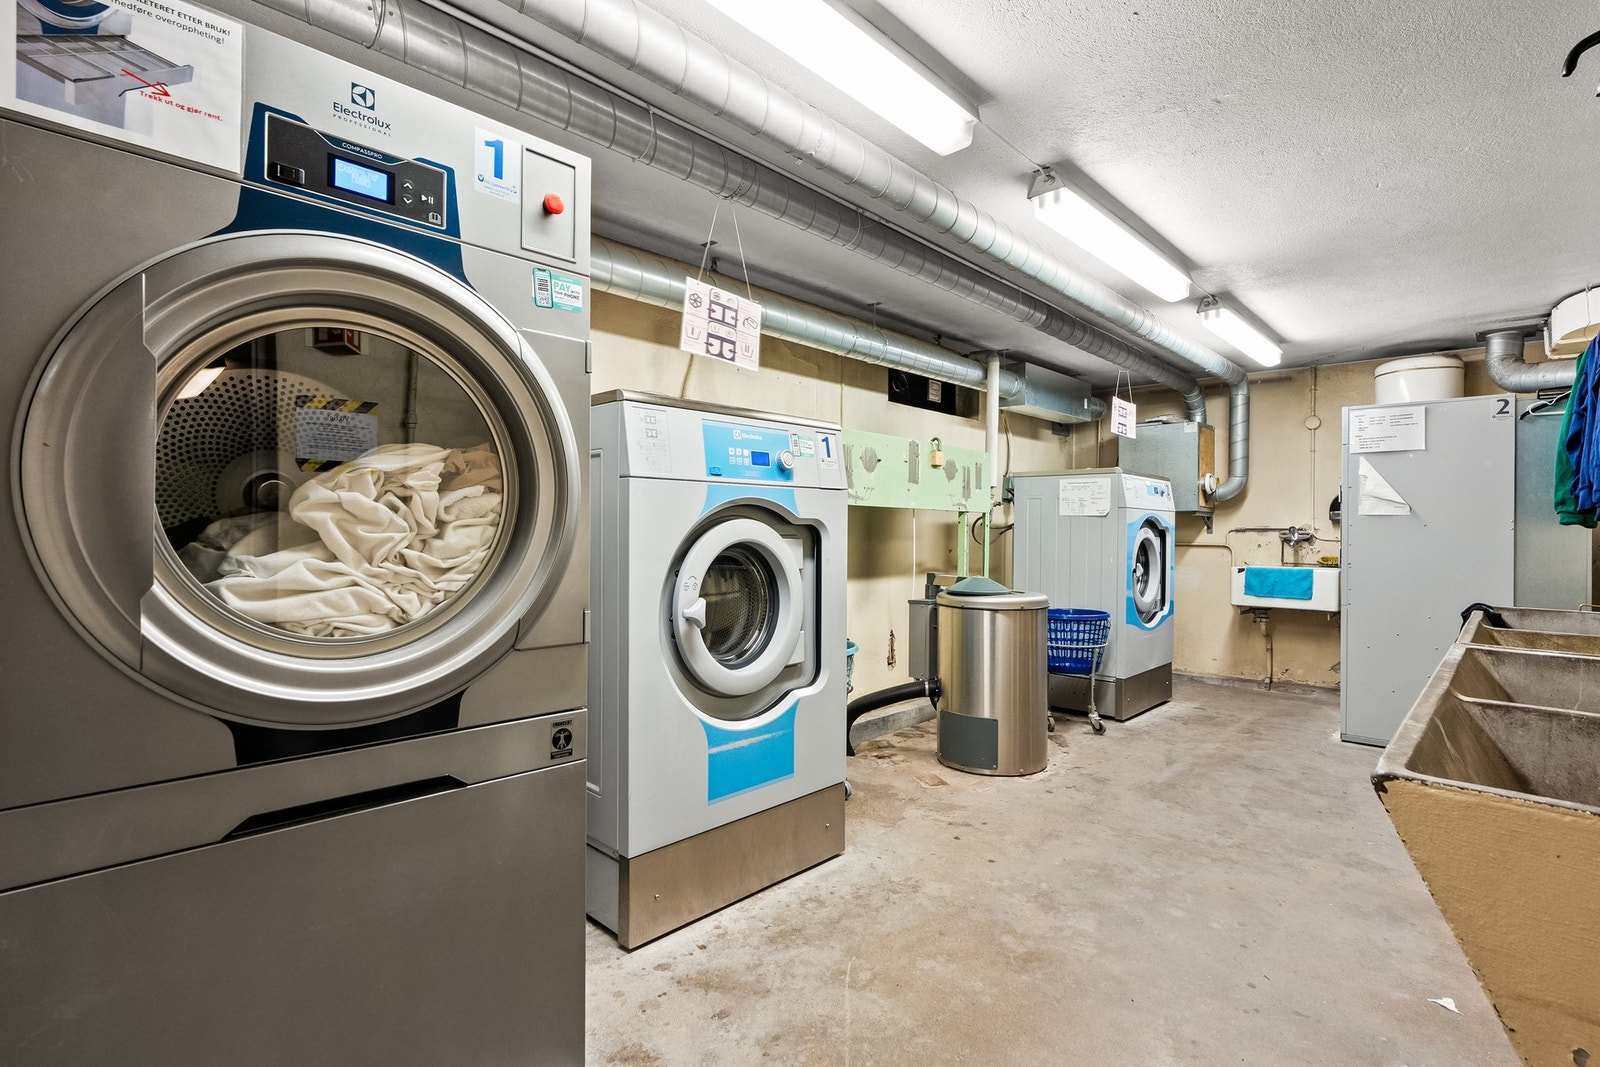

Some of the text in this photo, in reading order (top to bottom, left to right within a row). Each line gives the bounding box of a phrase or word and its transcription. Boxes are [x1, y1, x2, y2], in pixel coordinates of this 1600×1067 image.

[155, 14, 225, 45] overoppheting!
[177, 11, 203, 26] ETTER
[204, 21, 231, 37] BRUK!
[140, 90, 163, 103] Trekk
[175, 103, 185, 111] og
[333, 101, 391, 131] Electrolux
[333, 113, 391, 138] PROFESSIONAL
[341, 142, 383, 159] COMPASSPRO
[484, 139, 504, 180] 1
[553, 281, 571, 293] PAY
[563, 292, 580, 301] PHONE
[1496, 398, 1510, 415] 2
[821, 436, 831, 459] 1
